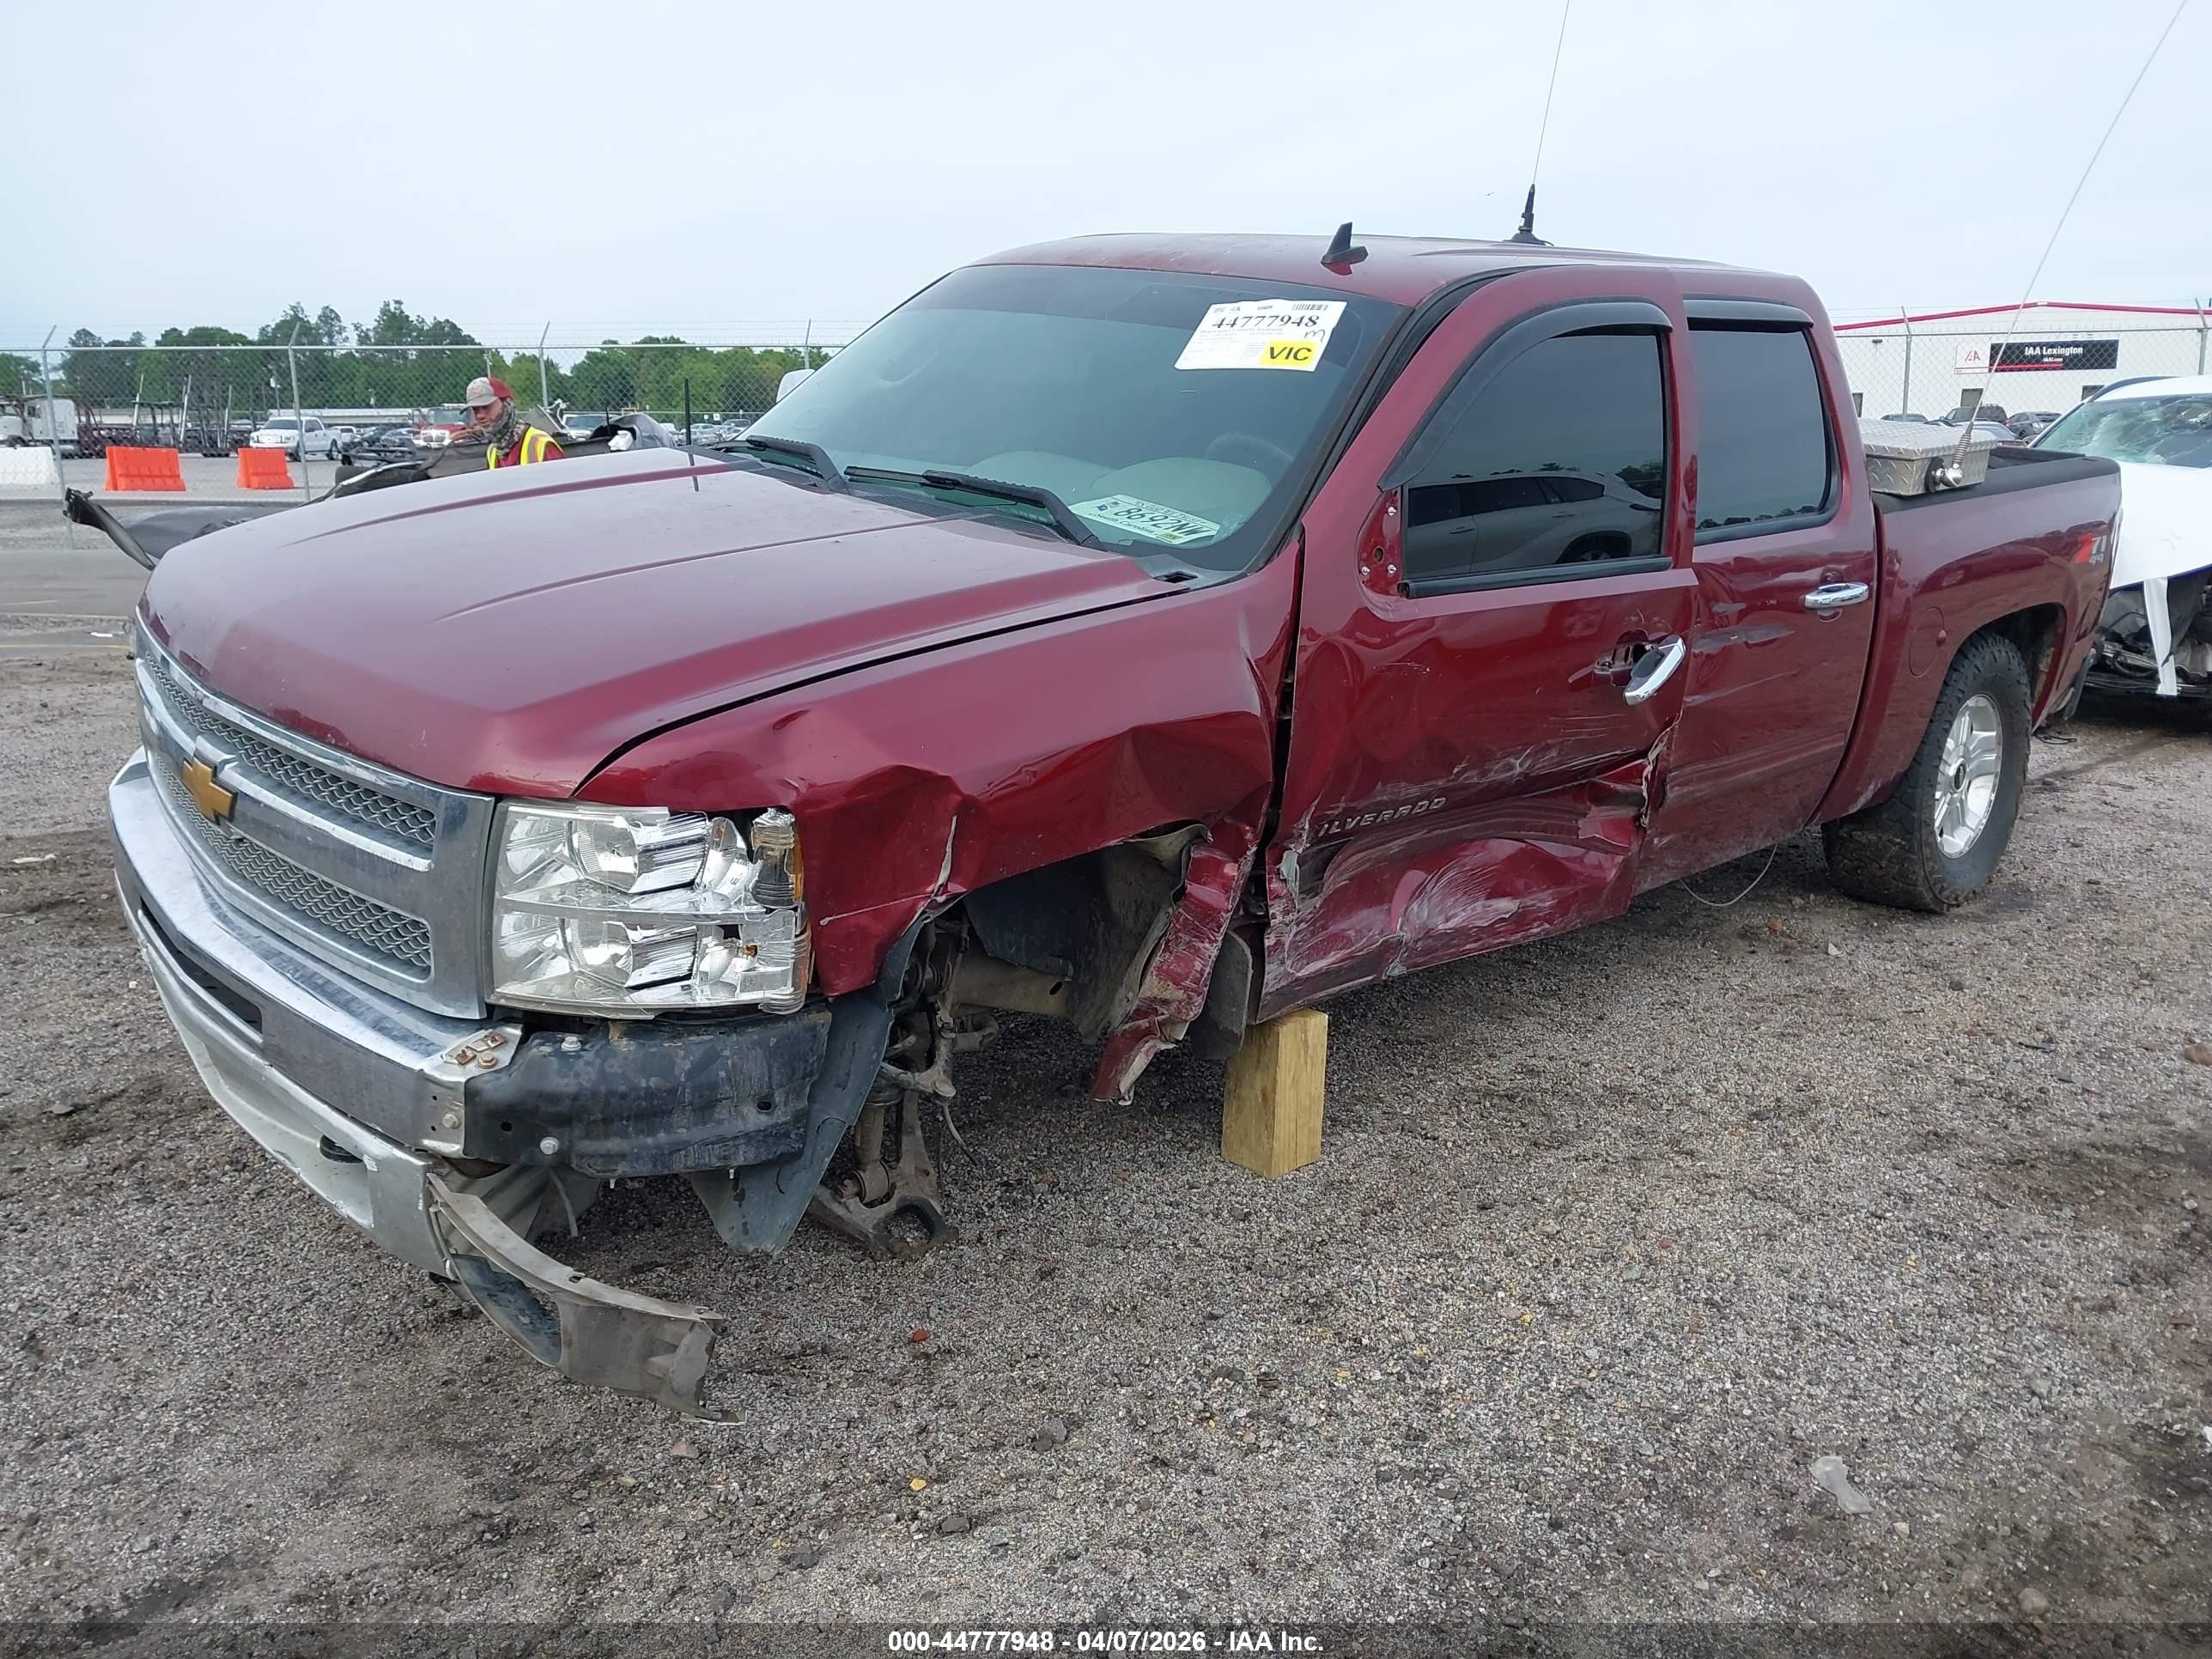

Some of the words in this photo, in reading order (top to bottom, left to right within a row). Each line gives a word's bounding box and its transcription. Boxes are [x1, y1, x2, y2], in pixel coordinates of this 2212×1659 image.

[1212, 314, 1320, 329] 44777948
[1269, 346, 1312, 362] VIC
[2025, 346, 2041, 356] IAA
[2042, 346, 2083, 356] Lexington
[1113, 507, 1212, 536] 8692NW
